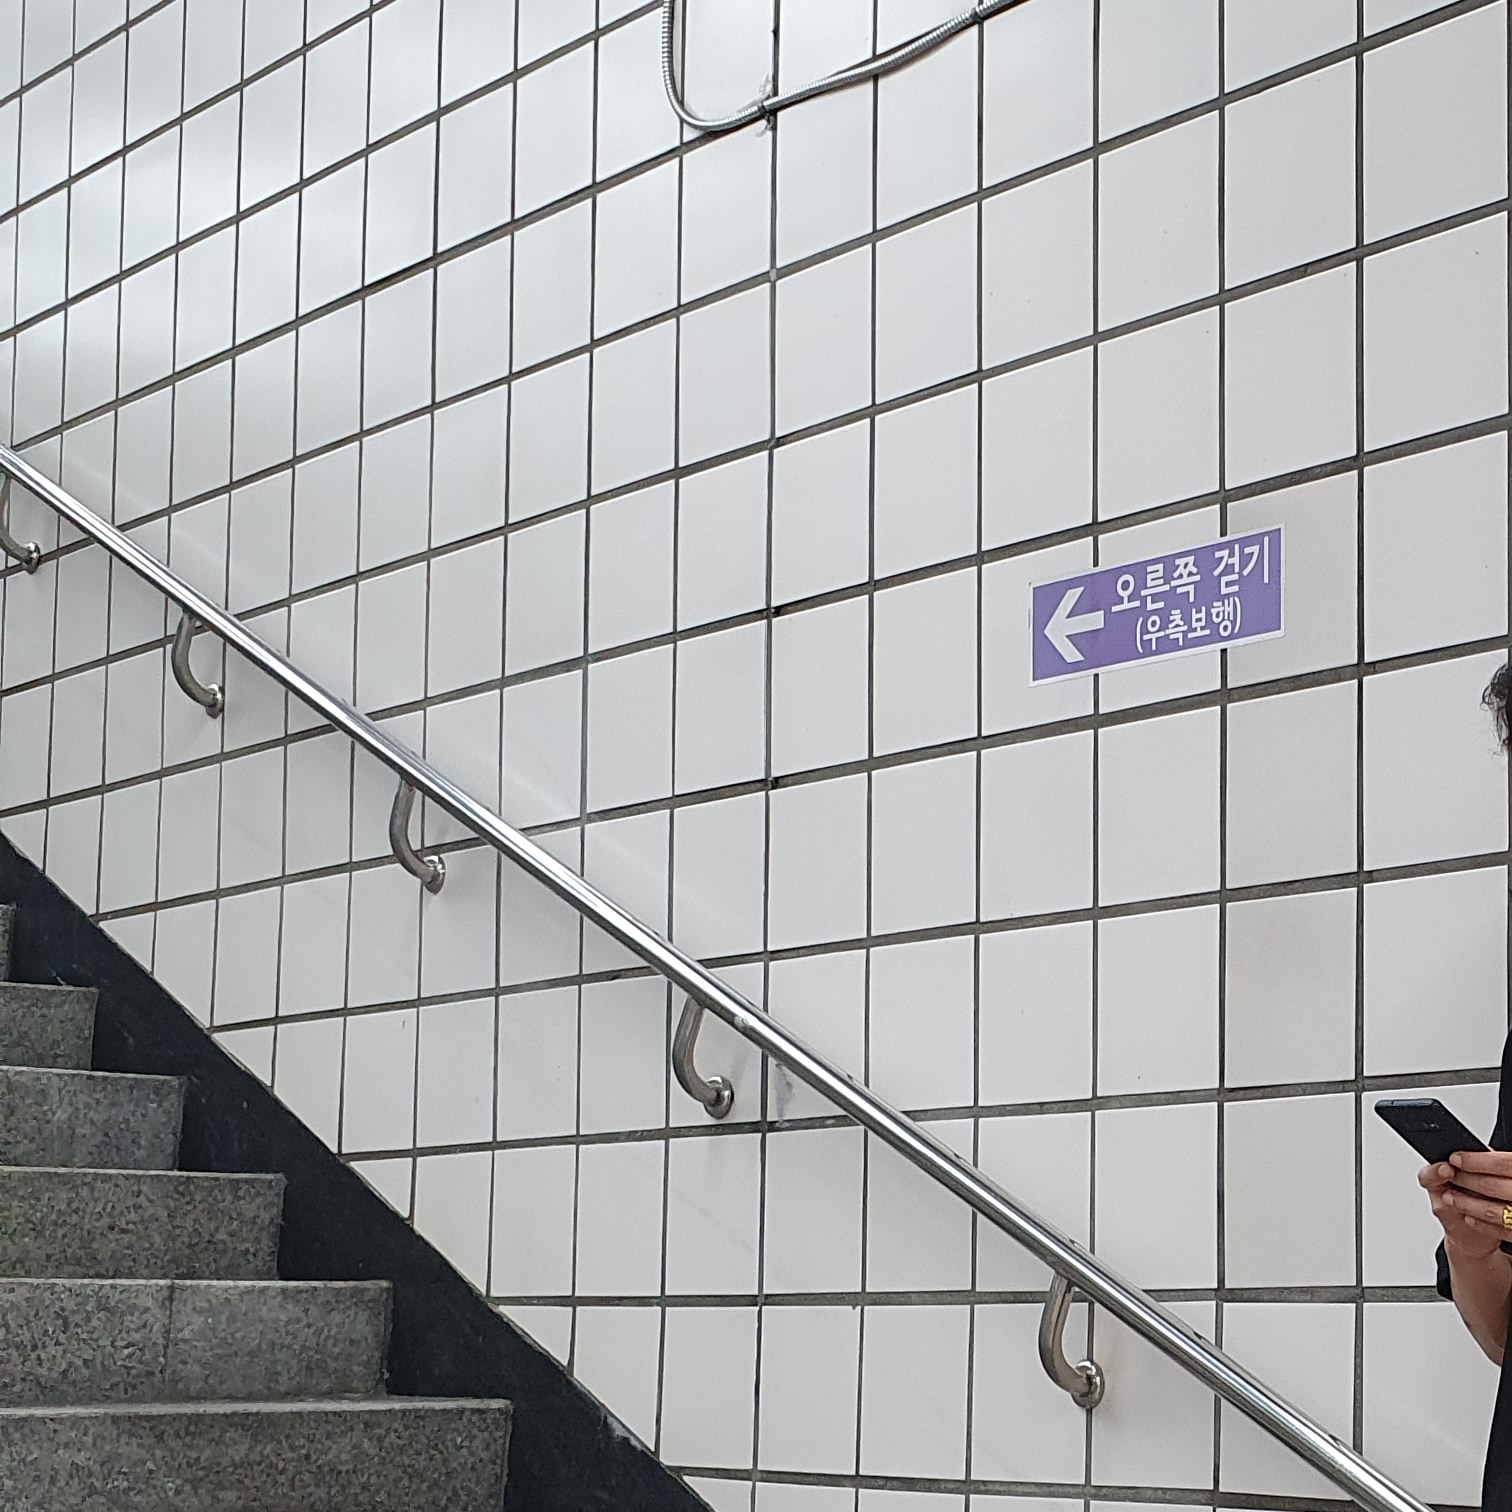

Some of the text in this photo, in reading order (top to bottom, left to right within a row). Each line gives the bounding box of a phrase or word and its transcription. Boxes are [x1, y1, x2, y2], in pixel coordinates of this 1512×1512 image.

[1111, 536, 1269, 612] 오른쪽 걷기
[1136, 597, 1242, 653] (우측보행)
